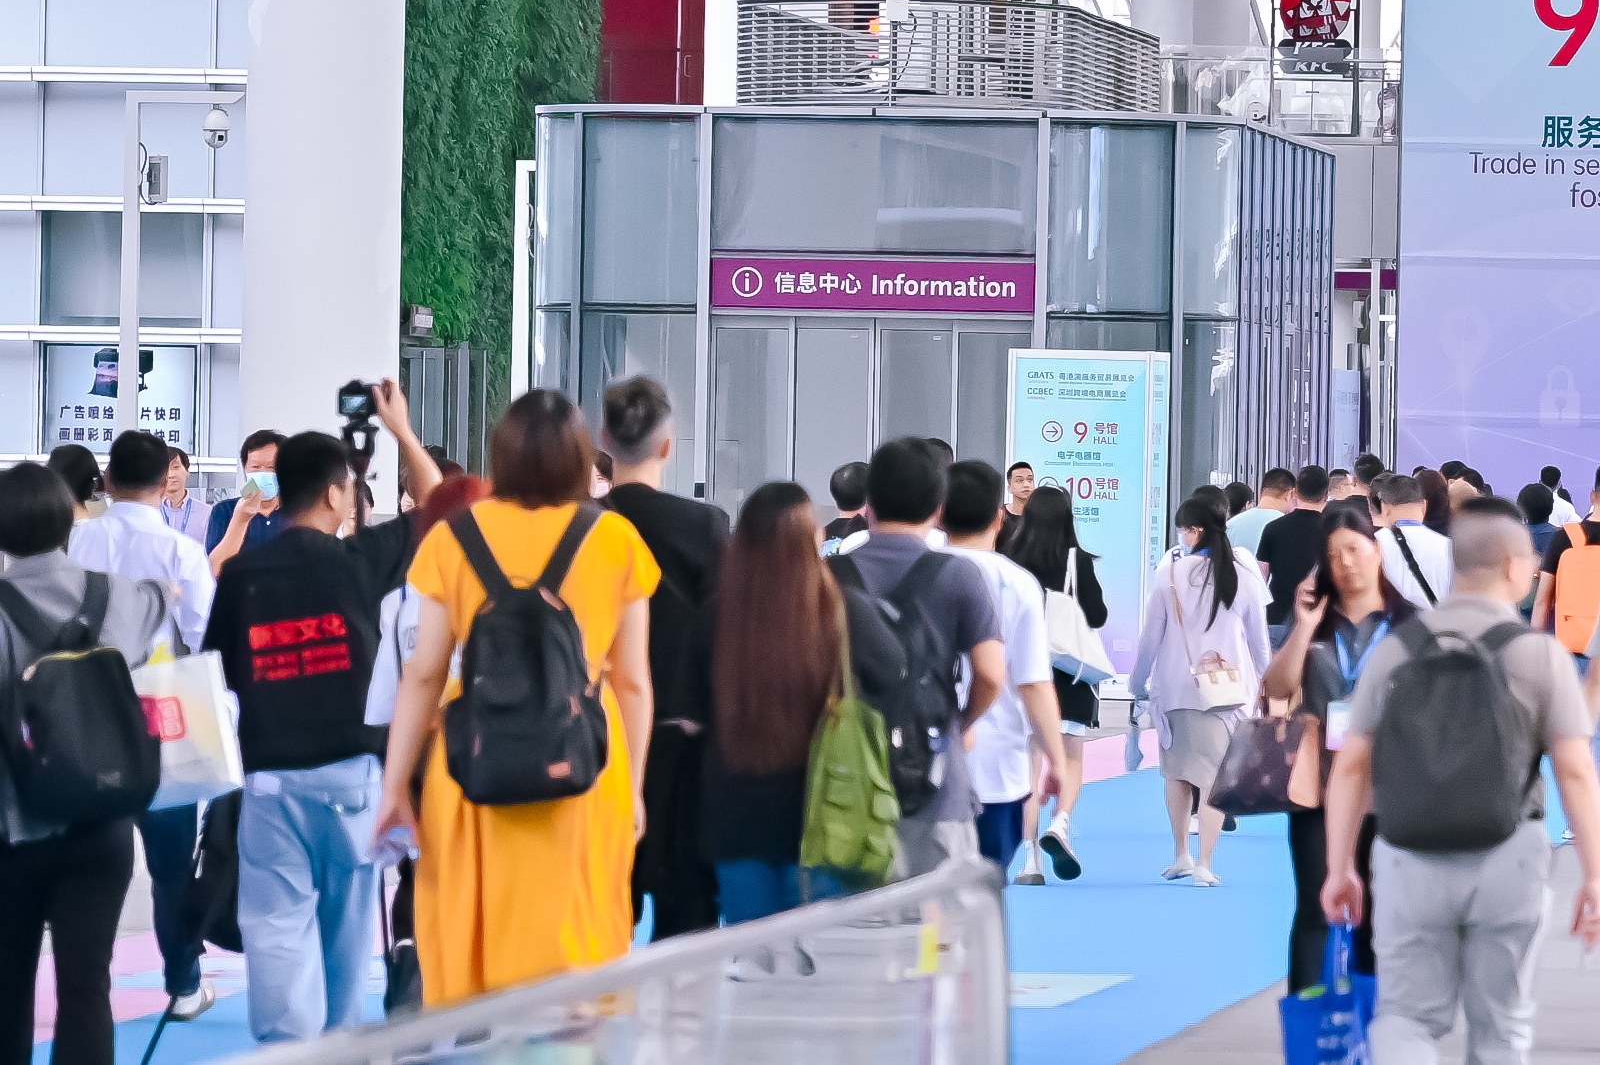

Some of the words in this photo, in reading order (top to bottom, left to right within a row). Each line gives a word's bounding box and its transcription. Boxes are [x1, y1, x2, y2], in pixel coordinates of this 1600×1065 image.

[1469, 151, 1537, 176] Trade
[1545, 152, 1566, 176] in
[774, 271, 862, 295] 信息中心
[872, 274, 1017, 298] Information
[1073, 421, 1089, 444] 9
[1094, 422, 1119, 435] 号馆
[1093, 436, 1118, 445] HALL
[1065, 476, 1093, 500] 10
[1094, 477, 1120, 491] 号馆
[1093, 491, 1119, 501] HALL
